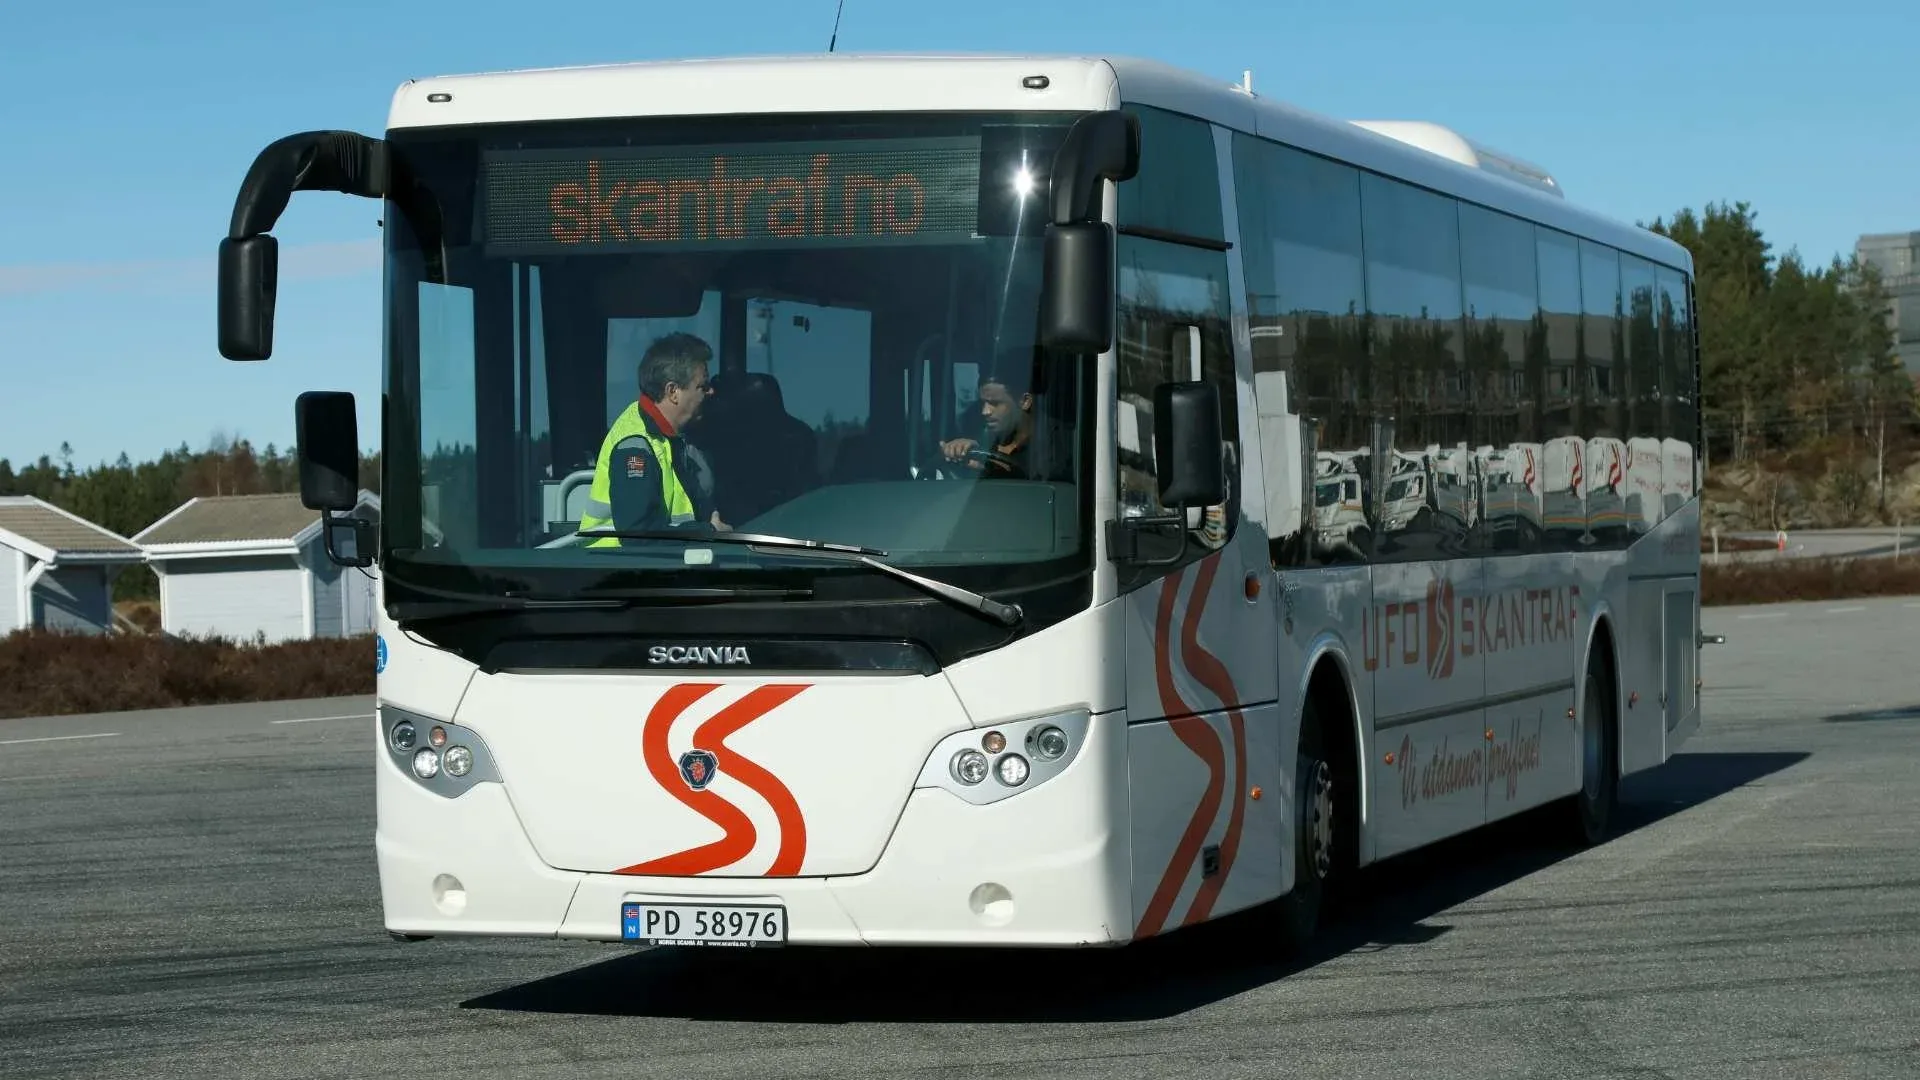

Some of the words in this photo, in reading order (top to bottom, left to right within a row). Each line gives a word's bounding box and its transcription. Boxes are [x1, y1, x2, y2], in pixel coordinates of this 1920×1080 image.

[548, 153, 924, 245] skantraf.no
[1362, 601, 1420, 672] UFO
[1460, 584, 1580, 658] SKANTRAF
[648, 645, 752, 665] SCANIA
[1399, 733, 1417, 811] Vi
[628, 925, 636, 934] N
[646, 910, 681, 936] PD
[694, 910, 778, 938] 58976
